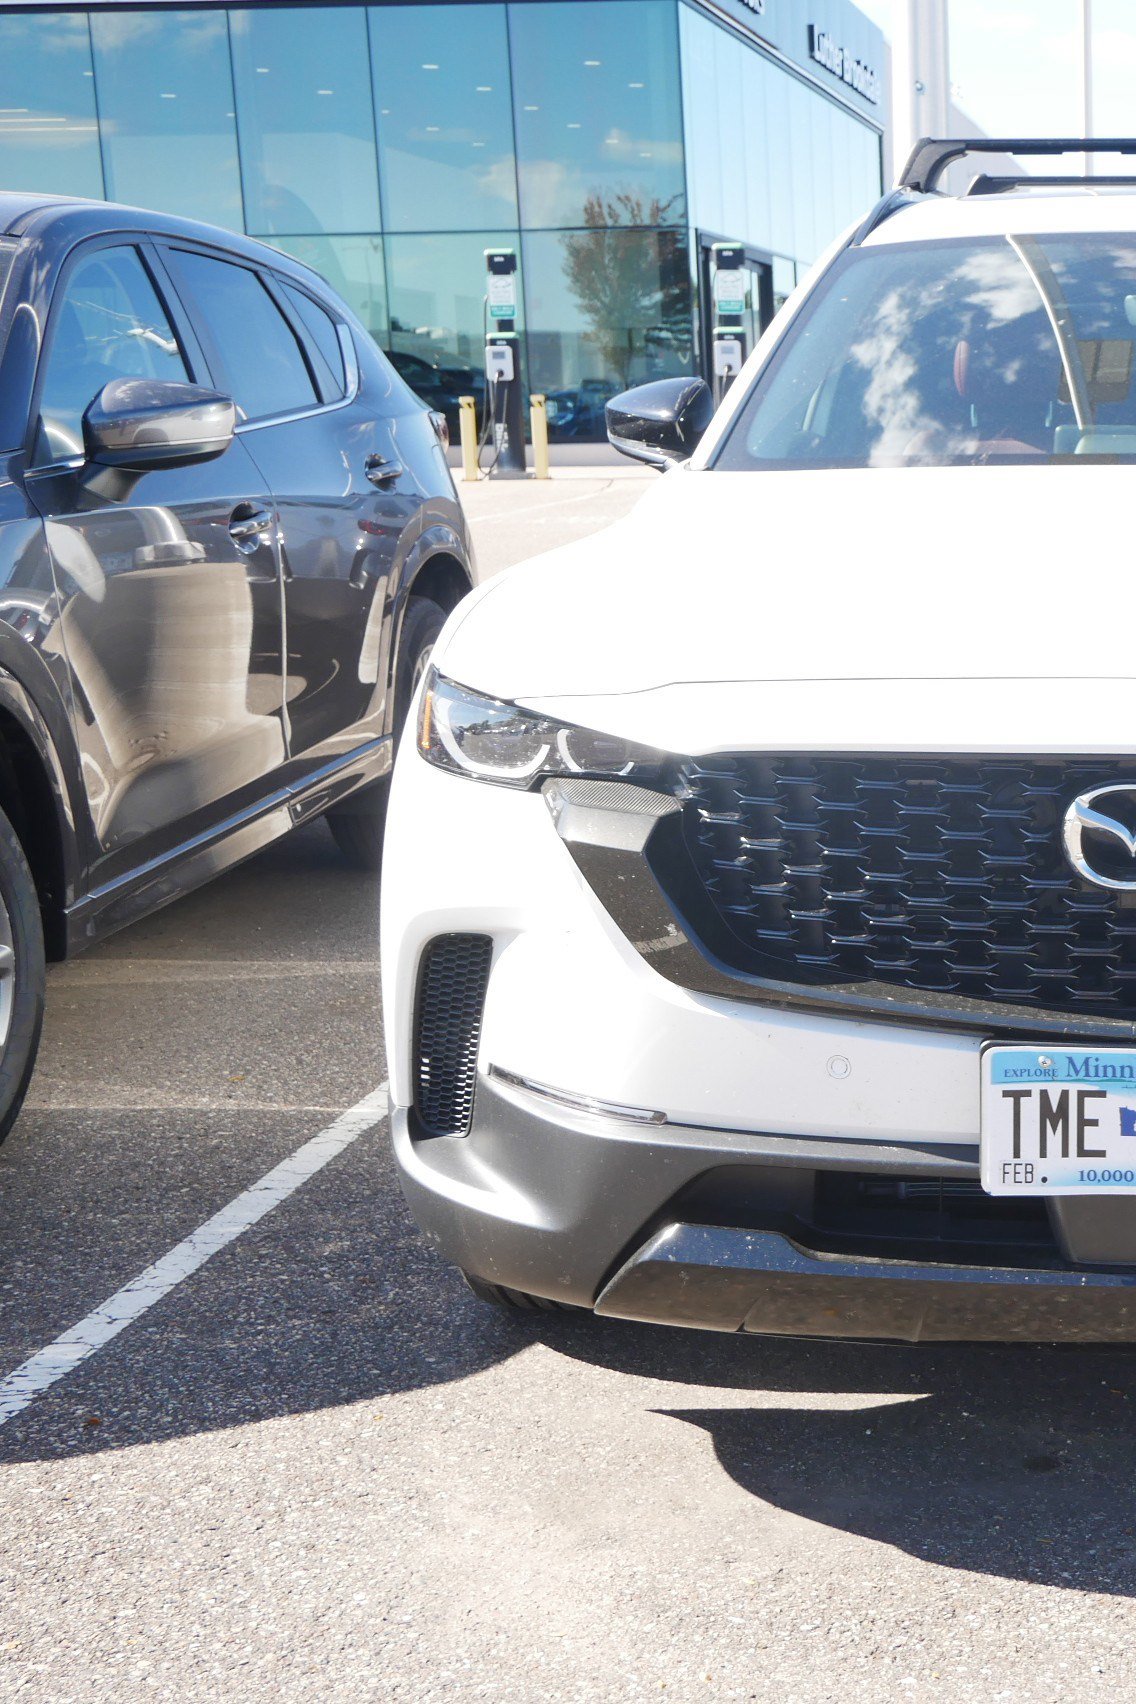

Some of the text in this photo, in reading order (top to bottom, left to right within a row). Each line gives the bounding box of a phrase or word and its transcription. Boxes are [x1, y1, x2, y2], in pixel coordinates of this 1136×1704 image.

[1003, 1067, 1059, 1079] EXPLORE
[1001, 1088, 1108, 1159] TME
[1002, 1162, 1034, 1184] FEB
[1077, 1169, 1135, 1184] 10,000
